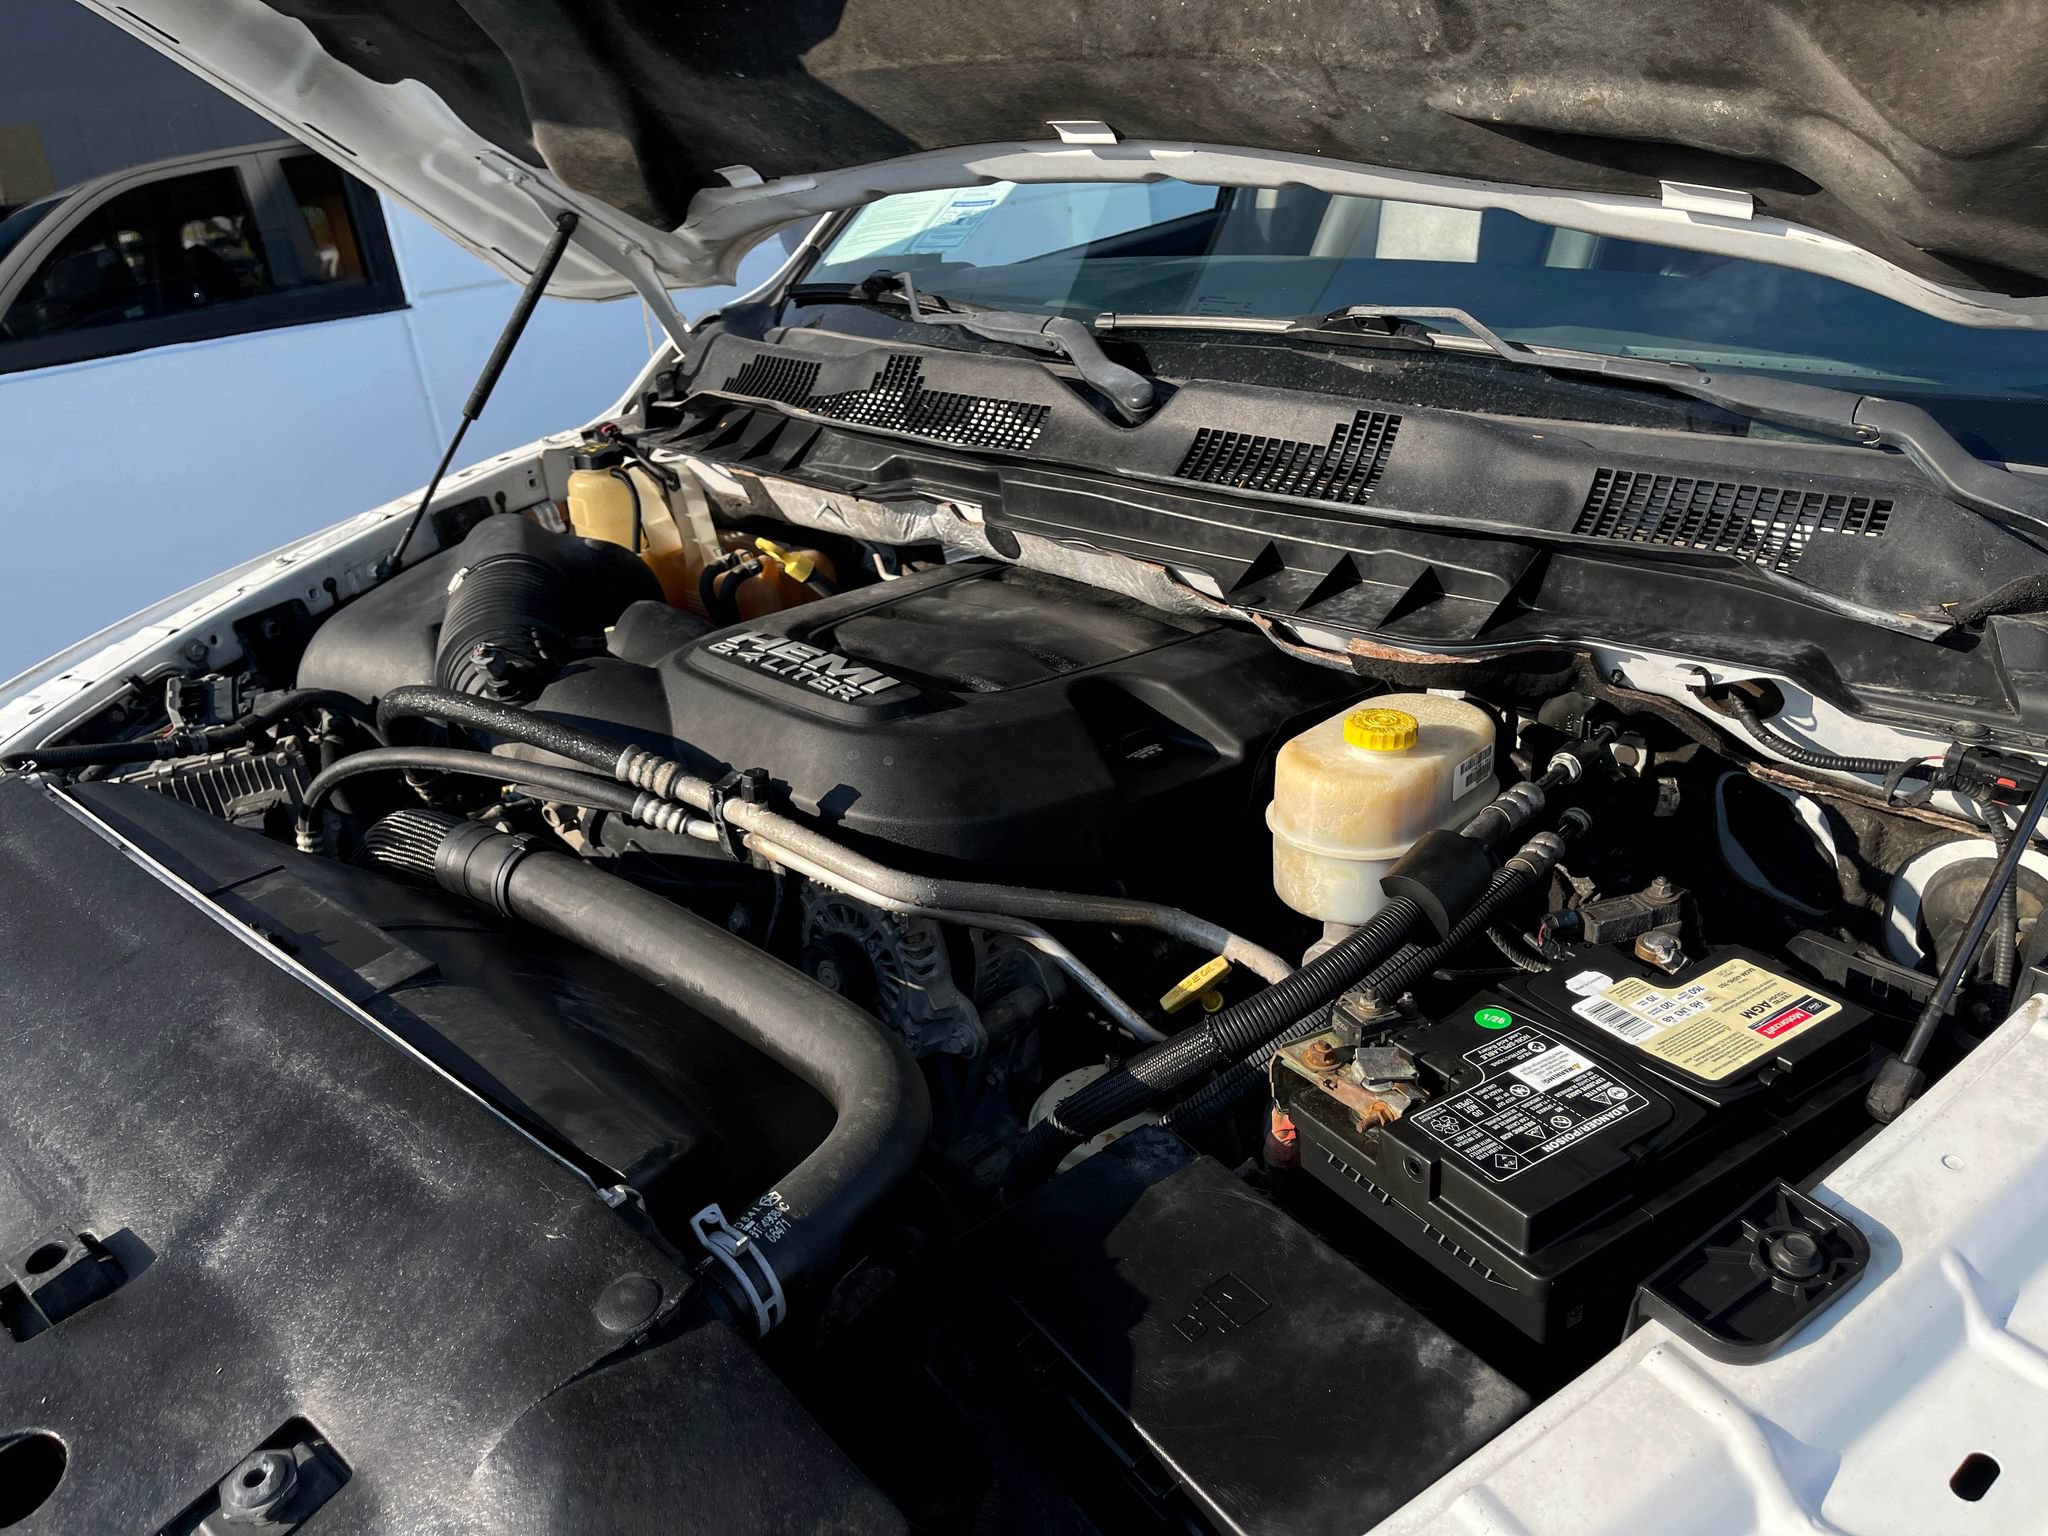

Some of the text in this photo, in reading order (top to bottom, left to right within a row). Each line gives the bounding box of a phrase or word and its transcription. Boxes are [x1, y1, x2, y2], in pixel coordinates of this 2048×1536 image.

[726, 631, 901, 695] HEMI
[760, 656, 863, 702] LITER
[1686, 985, 1705, 994] 760
[1644, 994, 1659, 1002] 70
[1771, 993, 1793, 1005] TESTED
[1658, 1000, 1676, 1009] 120
[1687, 1000, 1704, 1008] H6
[1738, 1000, 1774, 1019] AGM
[1660, 1014, 1676, 1022] 48
[1761, 1011, 1805, 1035] Motorcraft
[1478, 1034, 1532, 1060] NON-SPILLABLE
[1515, 1050, 1533, 1060] READ
[1450, 1097, 1474, 1110] OPEN.
[1461, 1103, 1479, 1113] NOT
[1470, 1109, 1485, 1117] DO
[1540, 1108, 1623, 1152] DANGER/POISON
[1498, 1131, 1514, 1140] ACID
